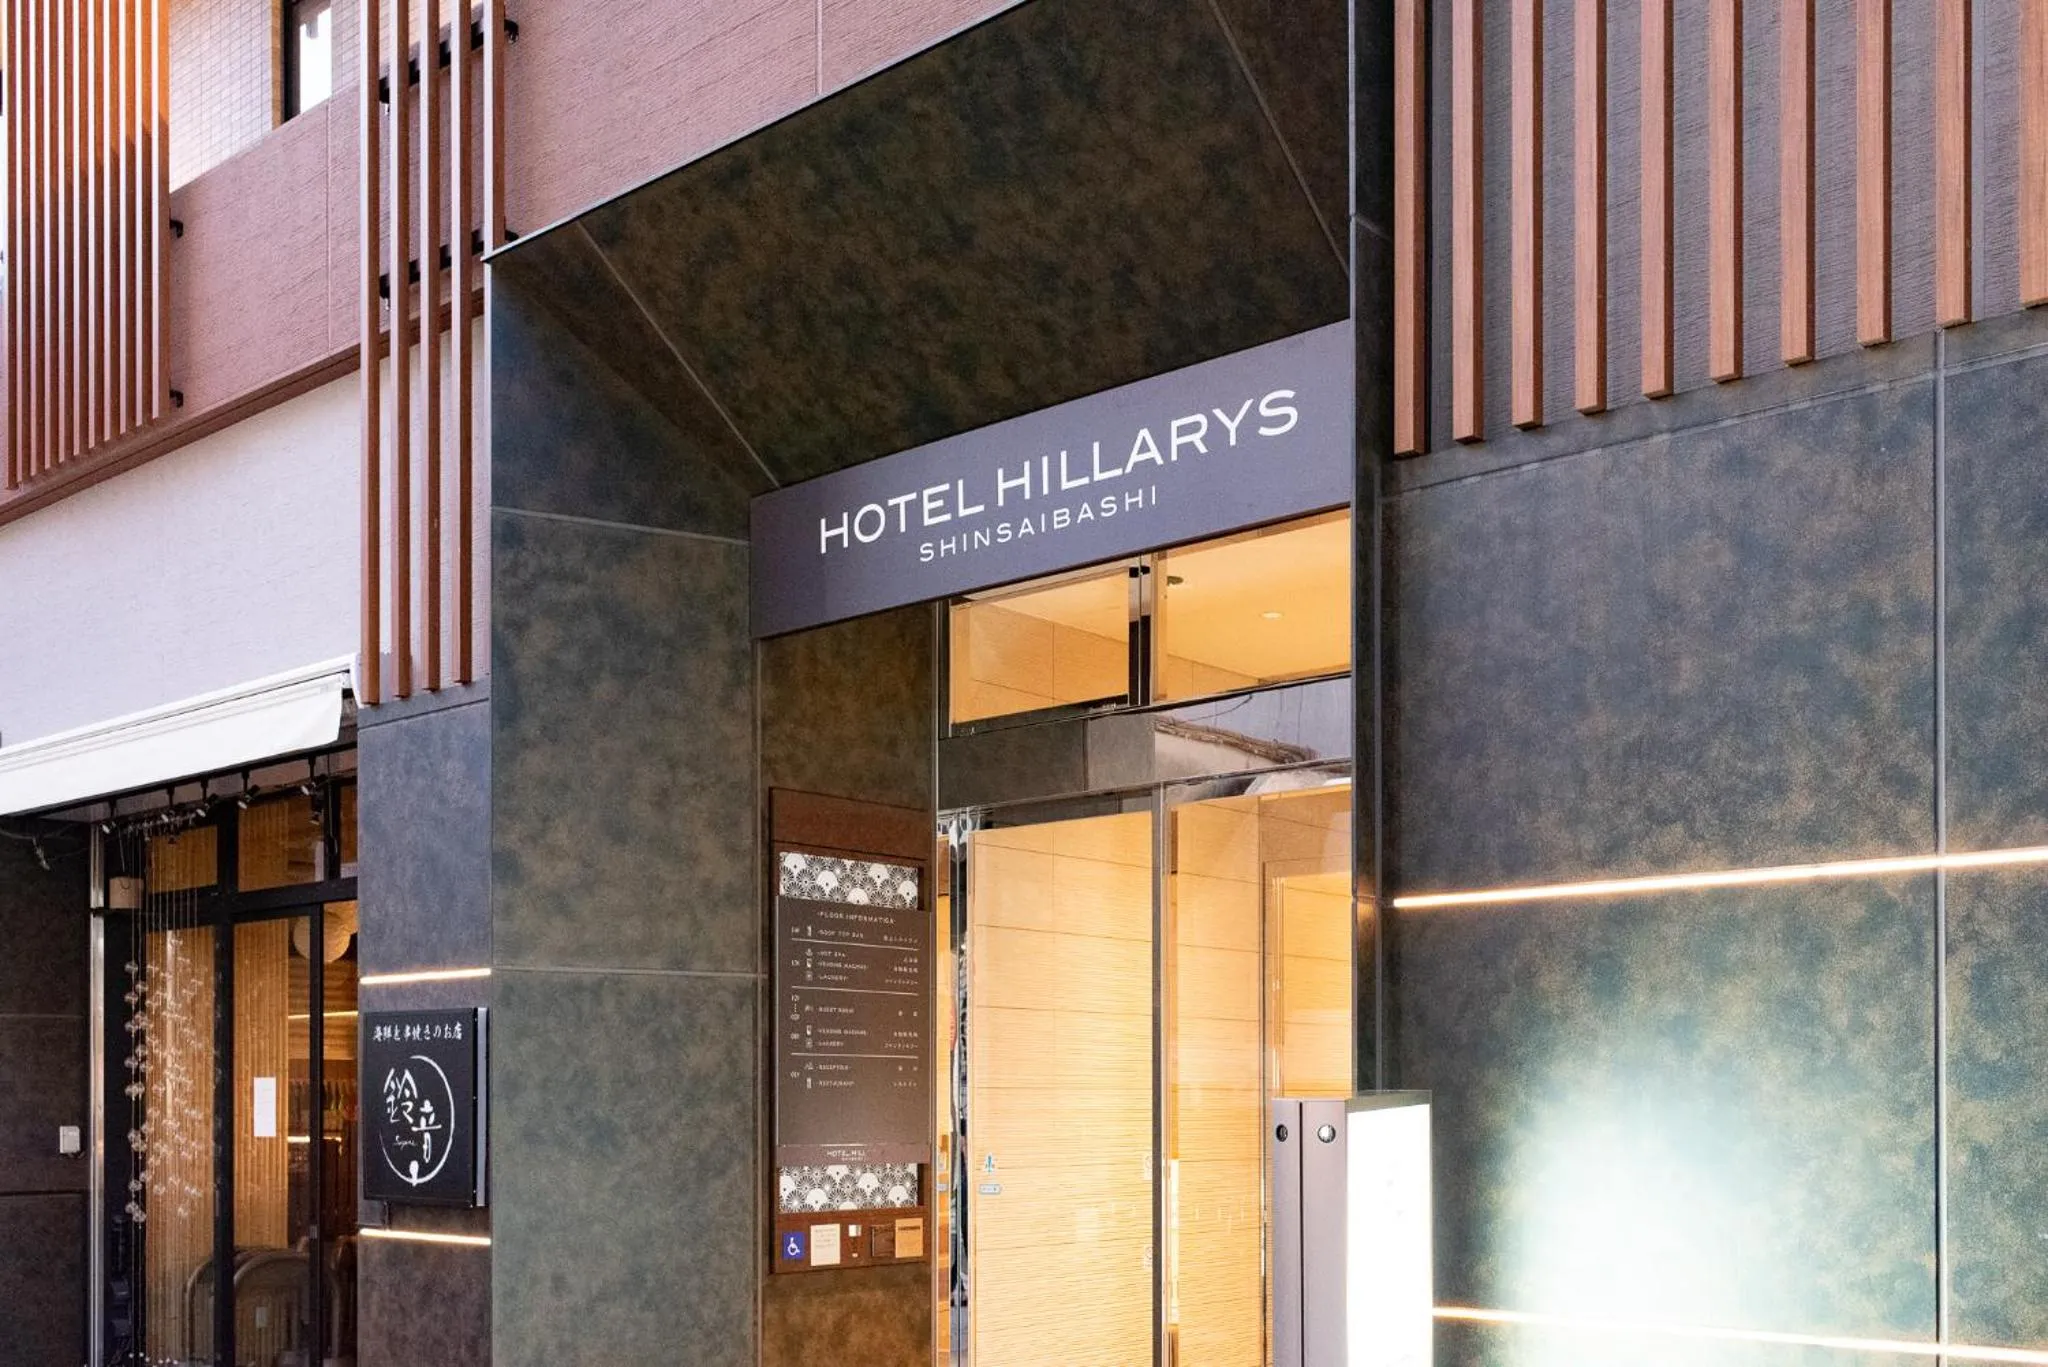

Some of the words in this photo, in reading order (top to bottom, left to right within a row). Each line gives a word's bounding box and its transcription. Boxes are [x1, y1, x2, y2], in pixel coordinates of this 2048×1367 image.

[820, 479, 984, 554] HOTEL
[997, 389, 1299, 507] HILLARYS
[918, 484, 1158, 563] SHINSAIBASHI
